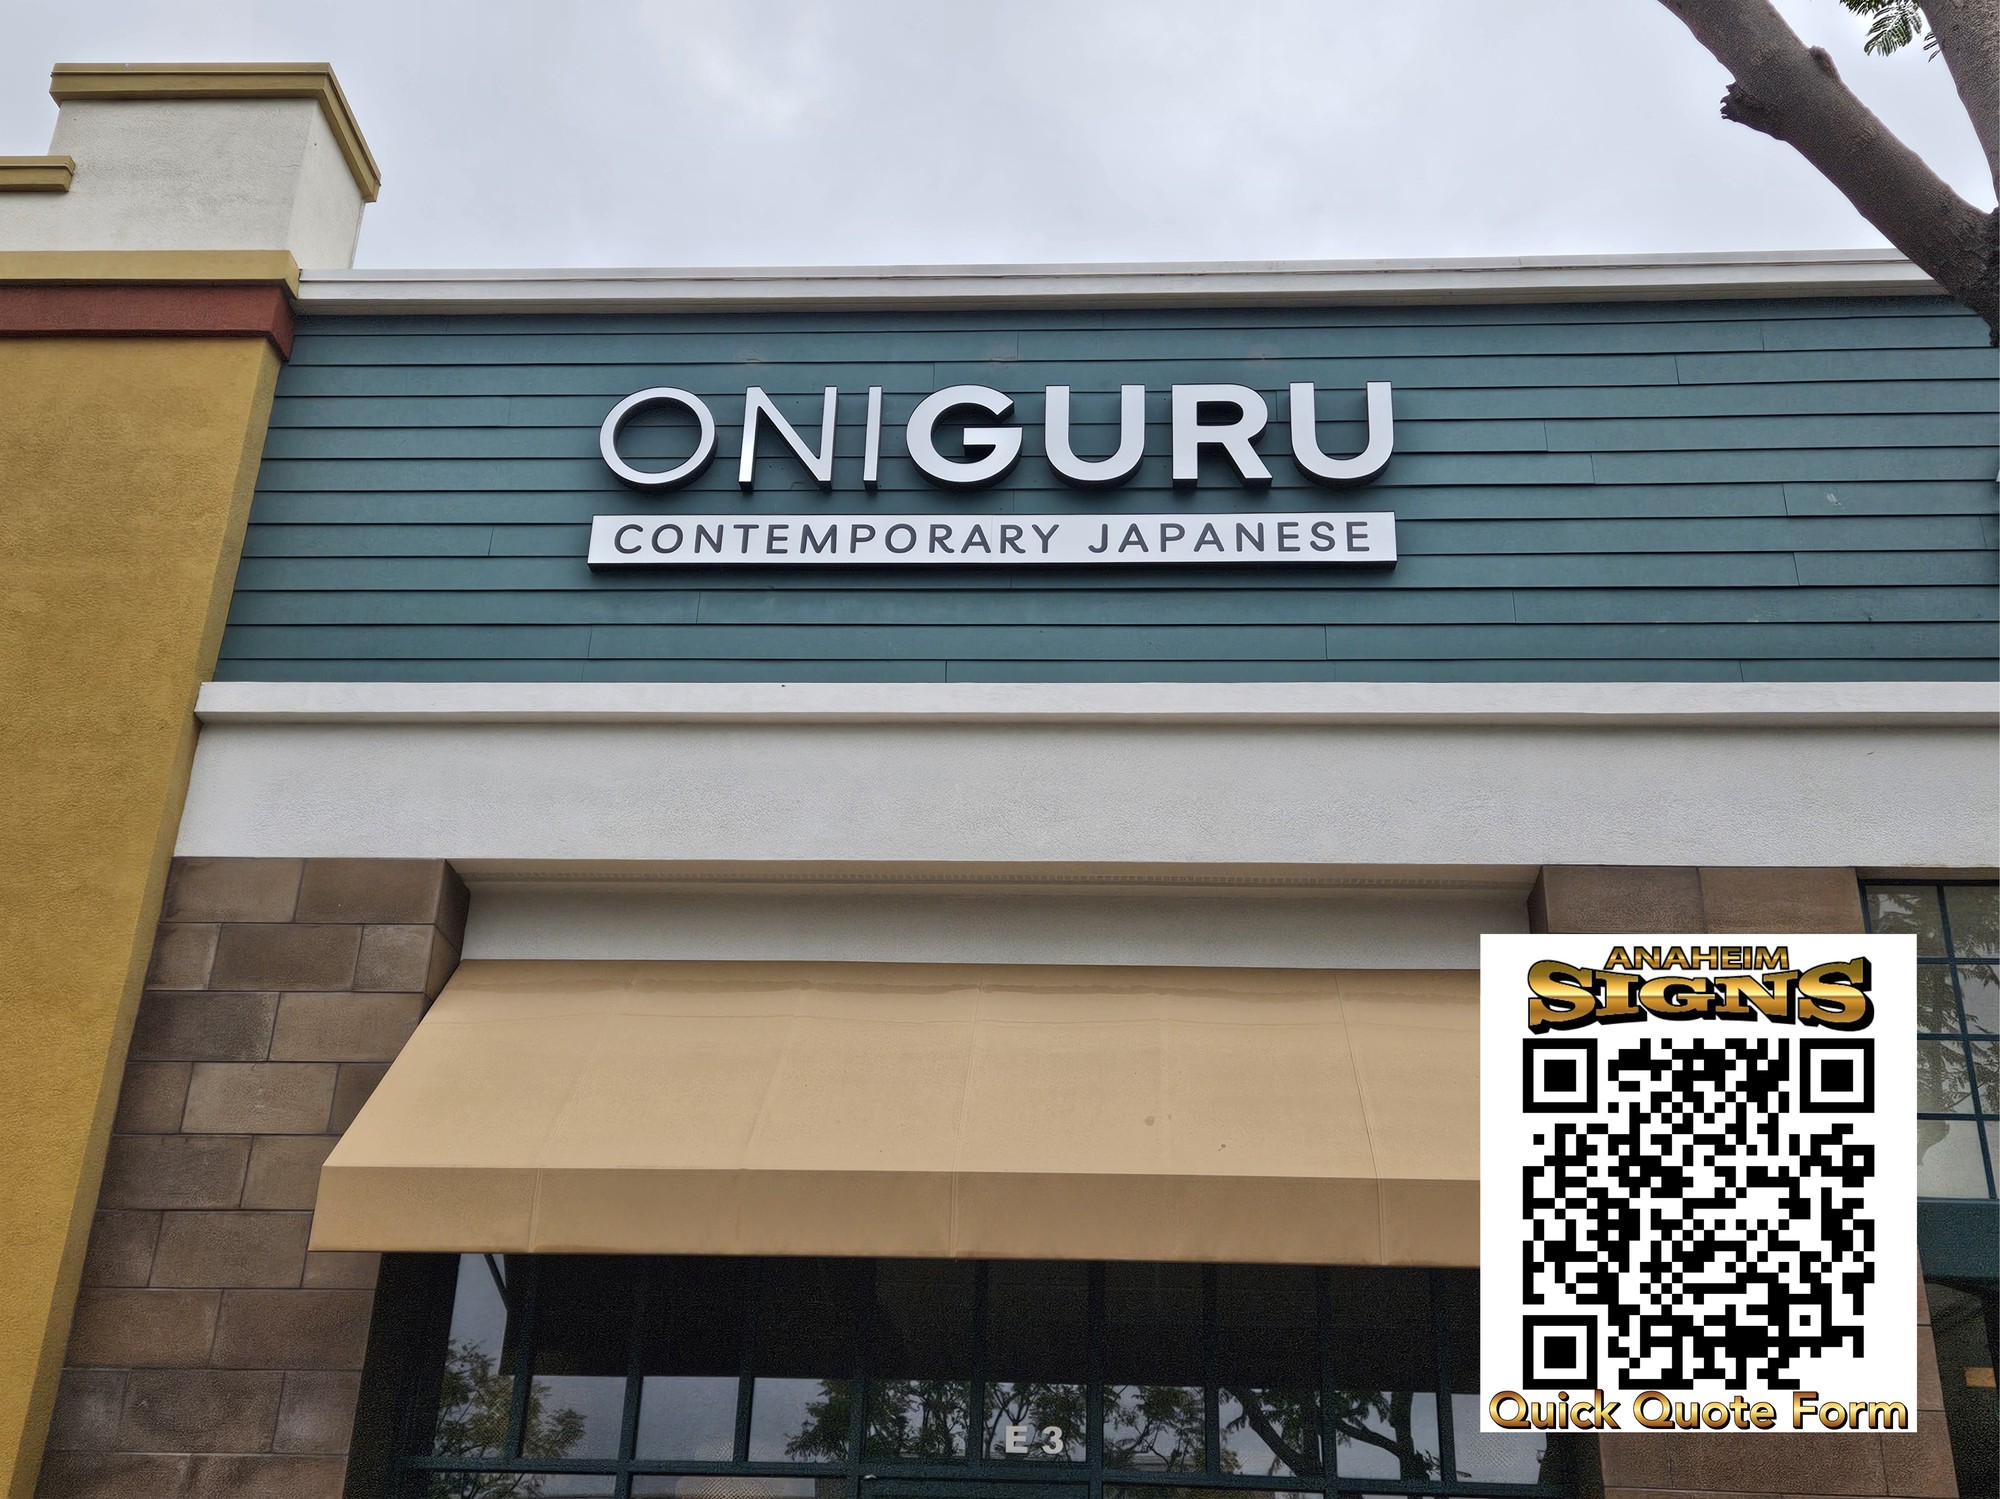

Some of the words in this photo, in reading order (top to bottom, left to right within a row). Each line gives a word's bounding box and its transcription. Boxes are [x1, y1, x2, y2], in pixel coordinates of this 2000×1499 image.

[599, 381, 1395, 490] ONIGURU
[613, 523, 1061, 555] CONTEMPORARY
[1088, 520, 1371, 554] JAPANESE
